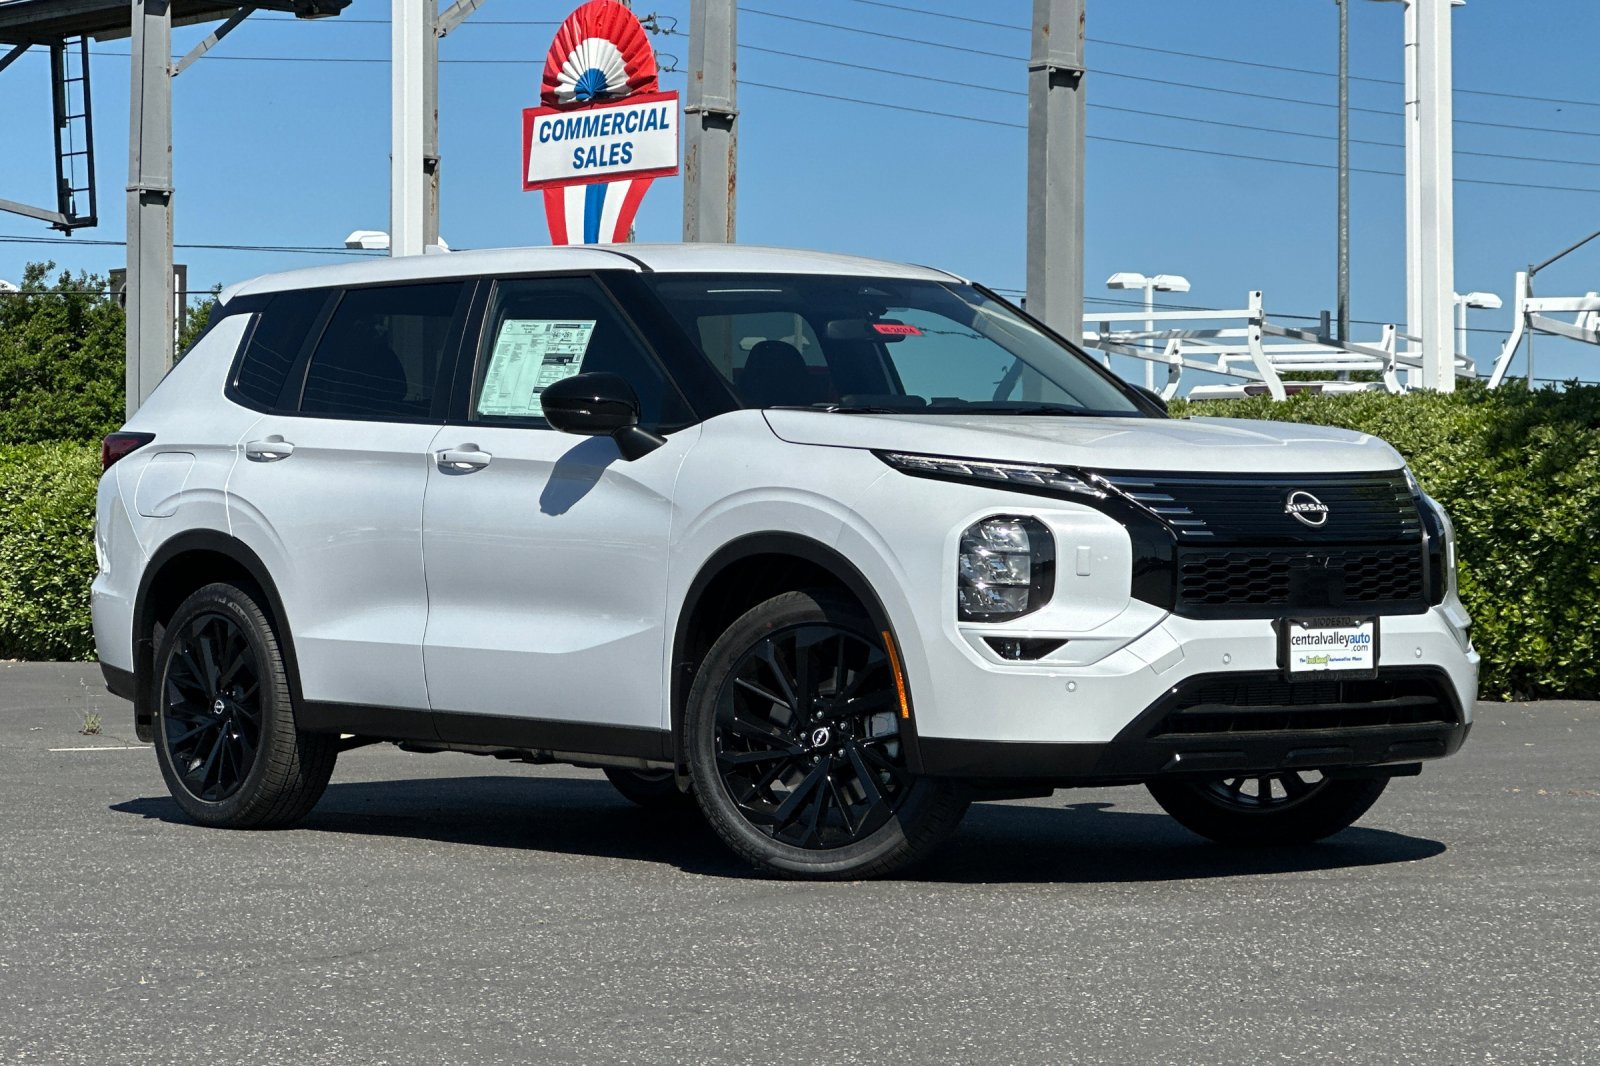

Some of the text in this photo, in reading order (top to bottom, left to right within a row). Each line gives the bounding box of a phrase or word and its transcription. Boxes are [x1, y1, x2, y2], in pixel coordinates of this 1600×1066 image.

[539, 107, 670, 144] COMMERCIAL
[572, 141, 634, 170] SALES
[1286, 503, 1329, 513] NISSAN
[1314, 617, 1351, 627] MODESTO
[1291, 631, 1371, 648] centralvalleyauto
[1351, 644, 1369, 652] .com
